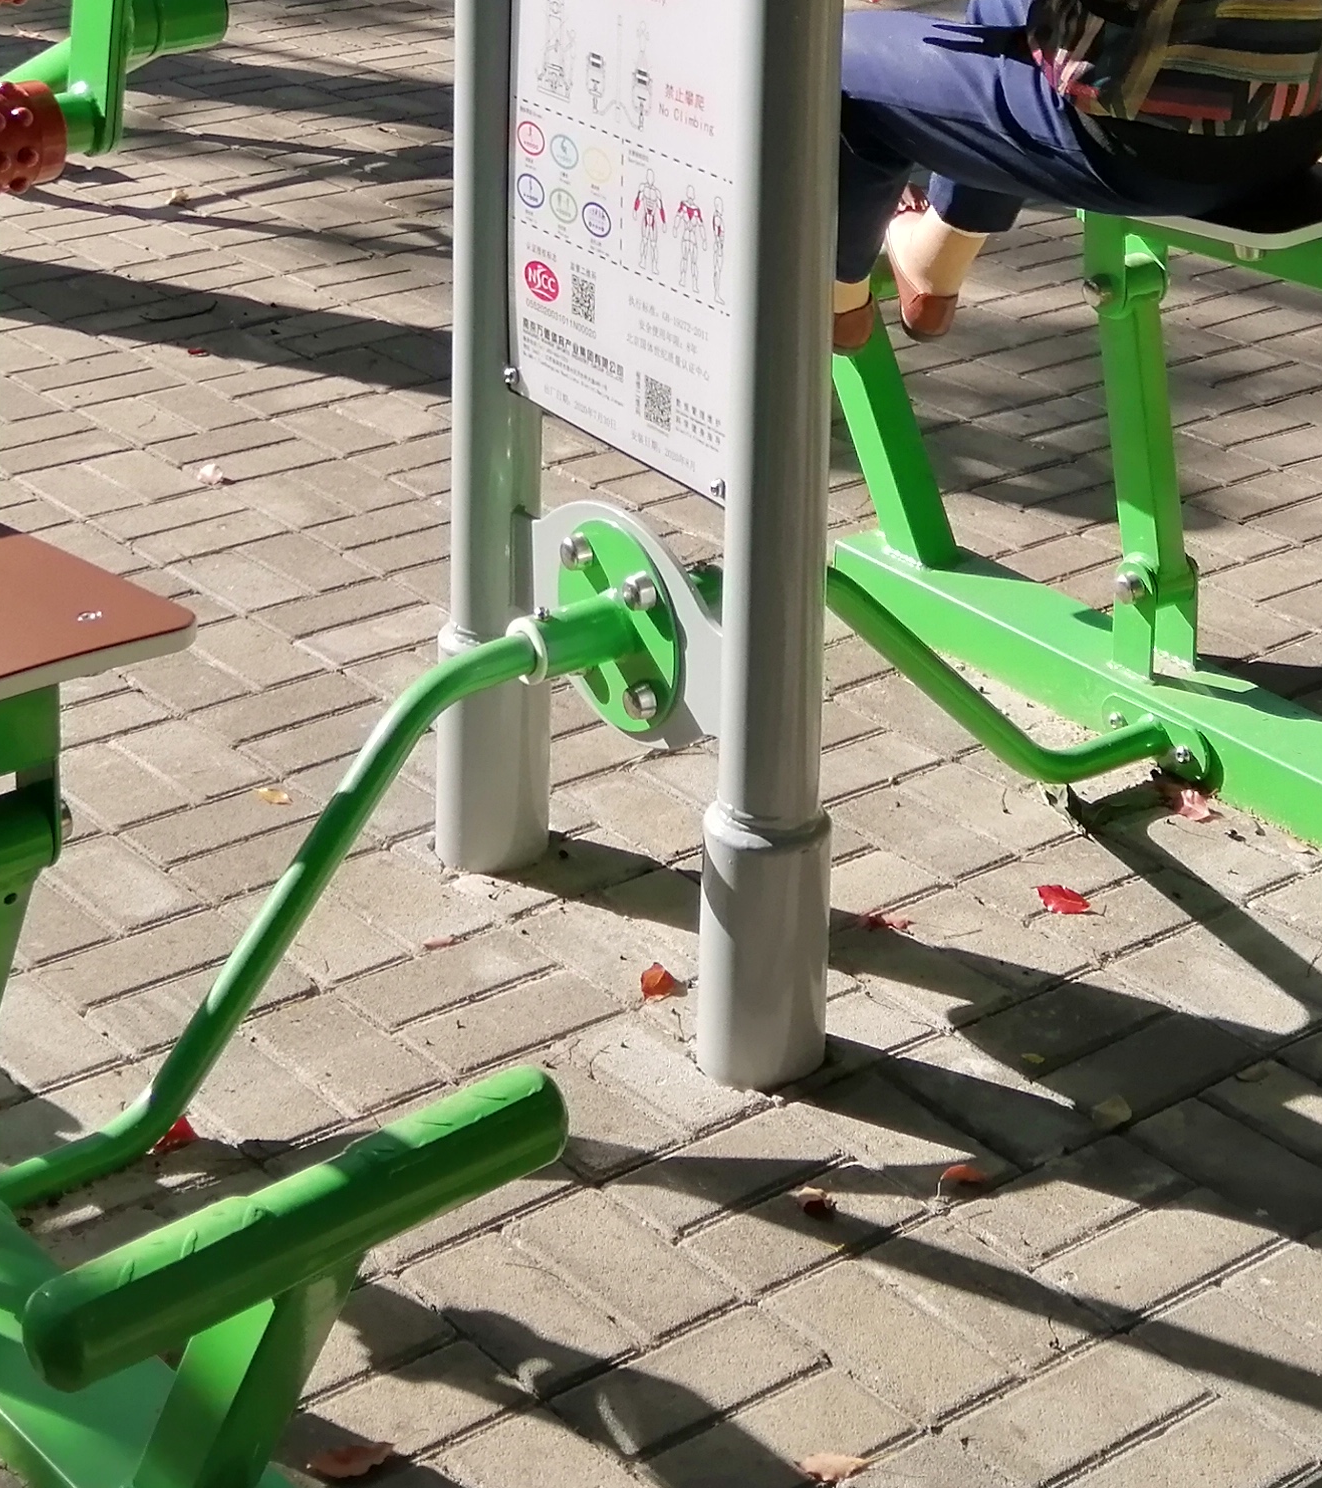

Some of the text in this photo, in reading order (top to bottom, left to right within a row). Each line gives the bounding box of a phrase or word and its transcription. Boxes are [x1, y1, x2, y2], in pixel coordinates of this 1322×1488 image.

[664, 82, 704, 111] 禁止攀爬
[658, 102, 714, 137] No Climbing
[528, 264, 556, 292] NSCC
